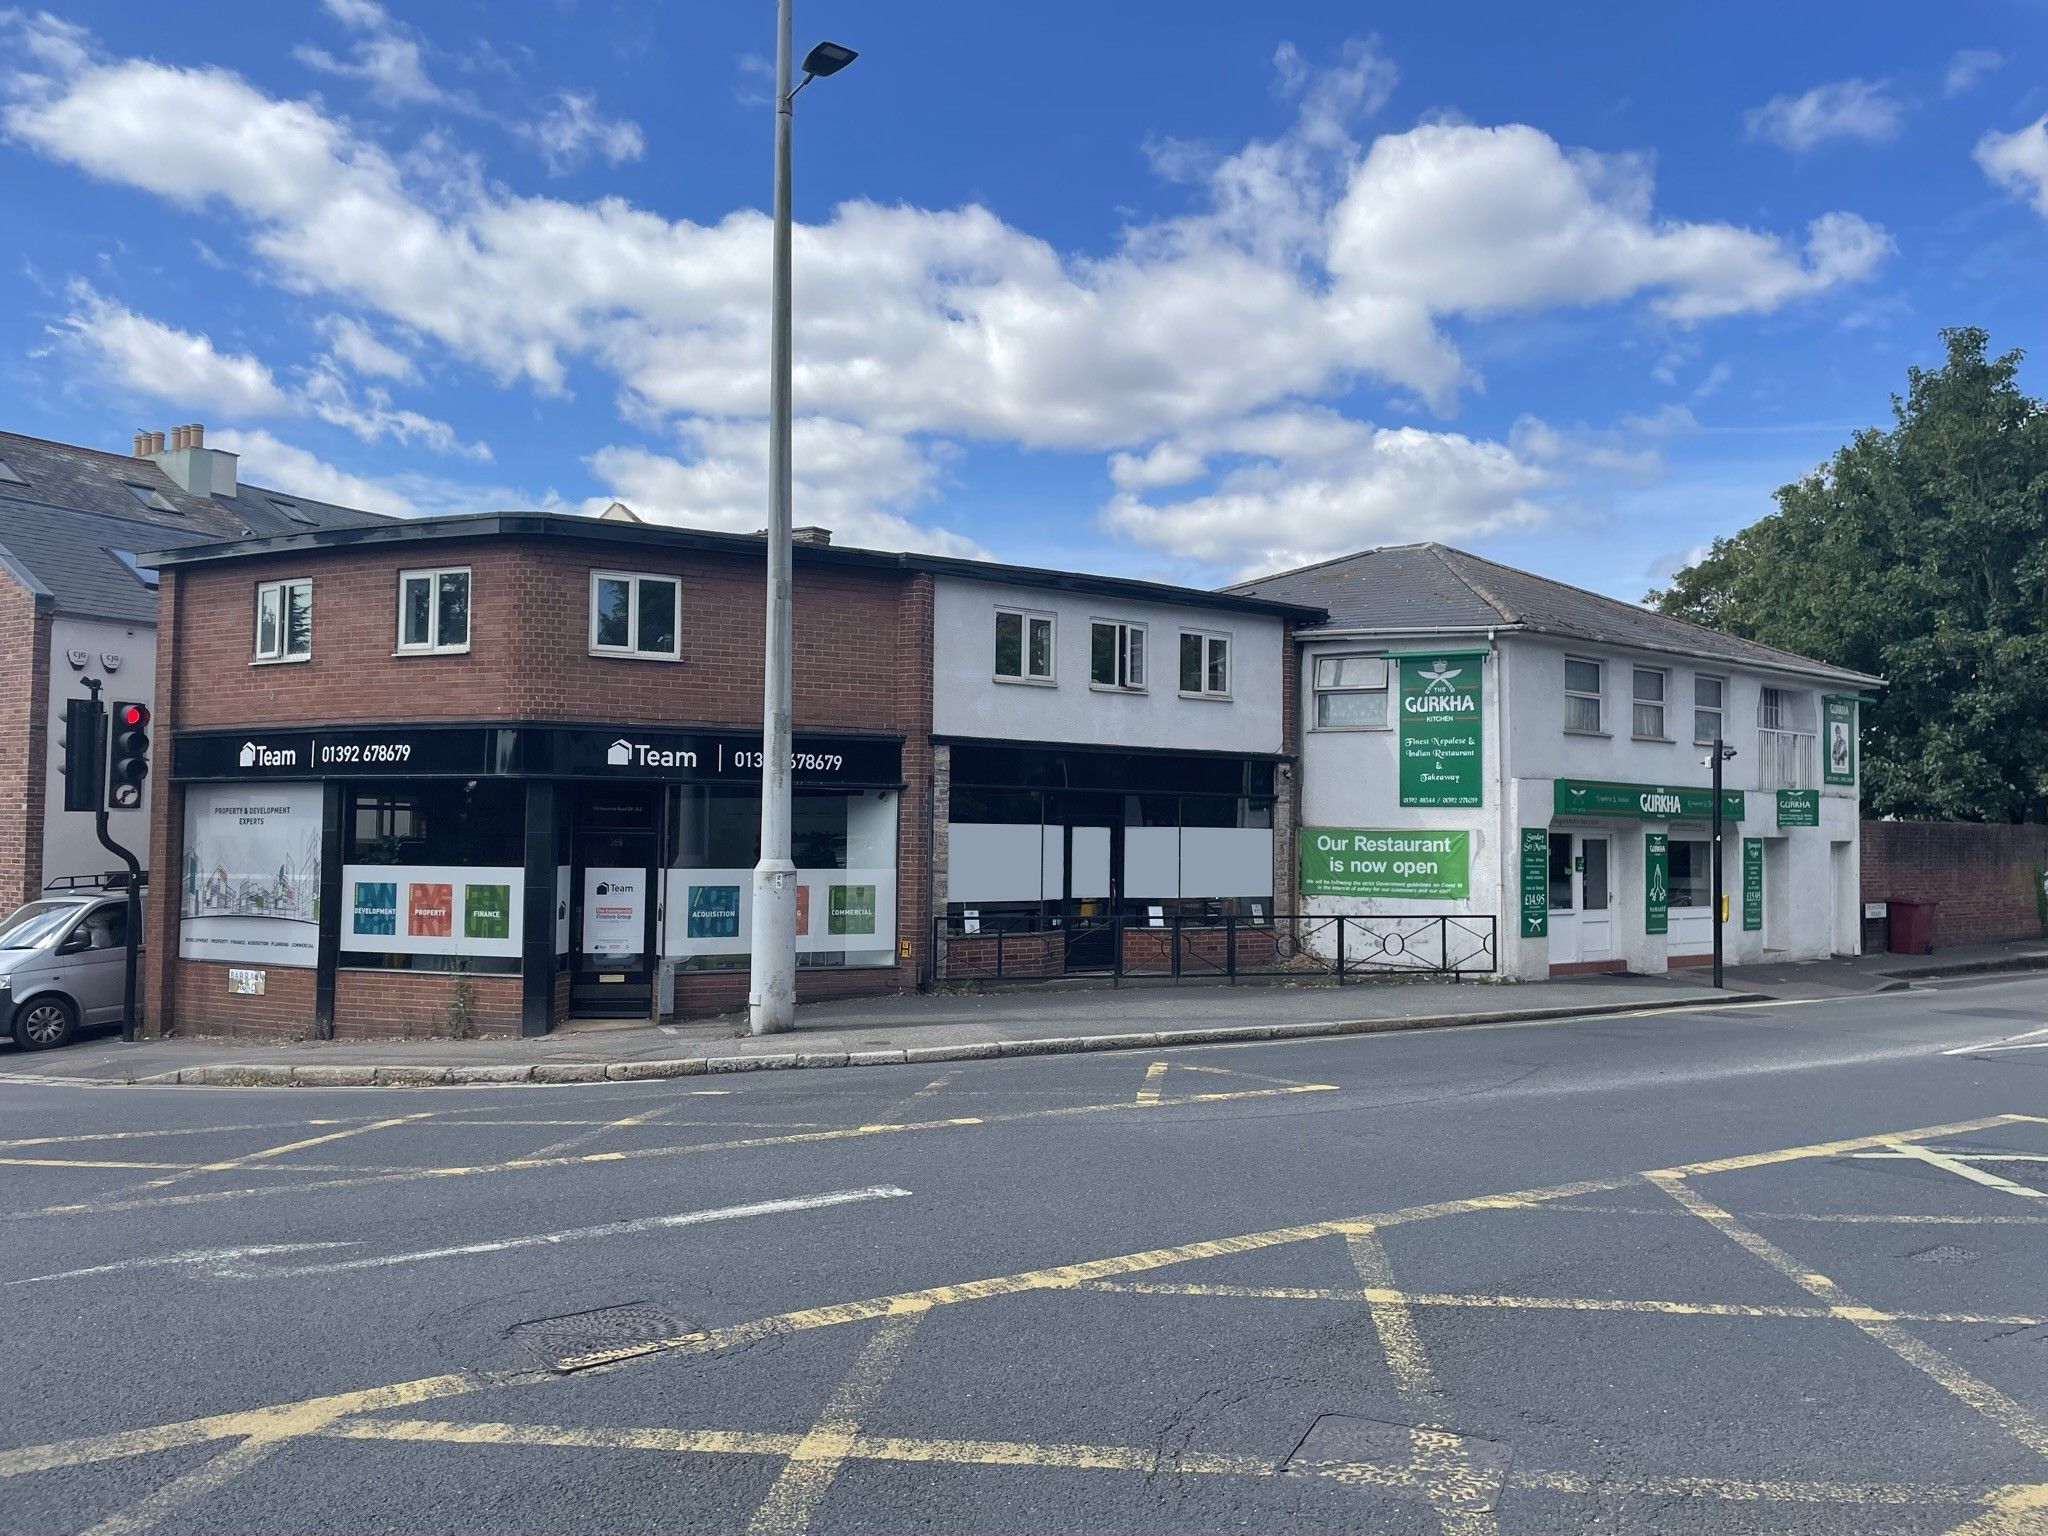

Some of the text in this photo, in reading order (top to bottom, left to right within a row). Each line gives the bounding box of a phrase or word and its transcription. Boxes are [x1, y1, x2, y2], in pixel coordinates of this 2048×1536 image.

[1405, 695, 1474, 712] GURKHA
[1405, 737, 1475, 746] Finest Nepalese &
[257, 745, 410, 766] Team 01392 678679
[635, 745, 842, 771] Team 013 678679
[1432, 749, 1474, 759] Restaurant
[1420, 774, 1459, 783] Takeaway
[1640, 794, 1681, 813] GURKHA
[1317, 835, 1451, 852] Our Restaurant
[1330, 857, 1438, 877] is now open
[611, 884, 633, 892] Team
[1525, 894, 1545, 905] £14.95
